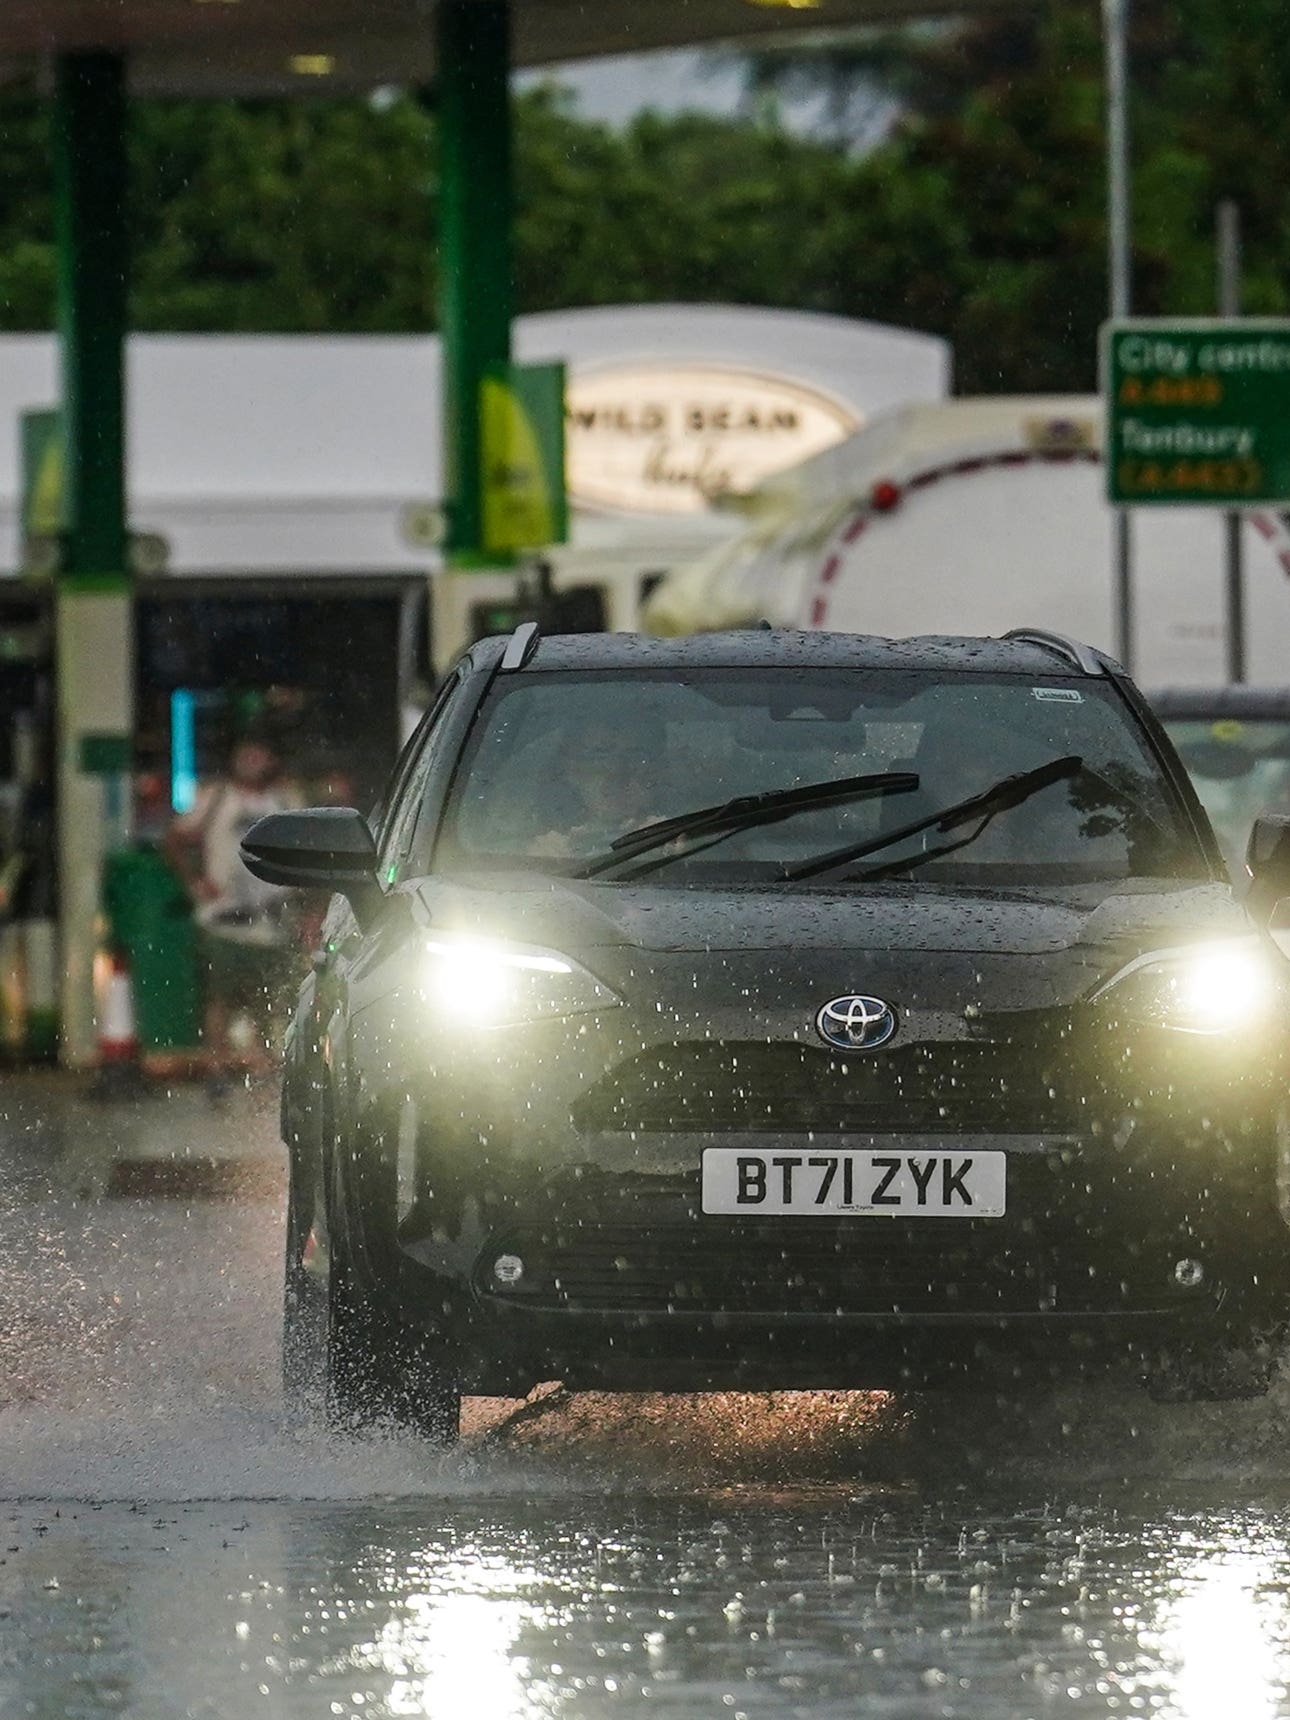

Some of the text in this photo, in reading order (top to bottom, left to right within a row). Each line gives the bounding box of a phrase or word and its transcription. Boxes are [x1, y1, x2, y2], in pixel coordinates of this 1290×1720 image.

[1117, 337, 1189, 374] City
[686, 404, 798, 430] BEAN
[1121, 418, 1252, 455] Tenbury
[736, 1157, 973, 1206] BT71 ZYK
